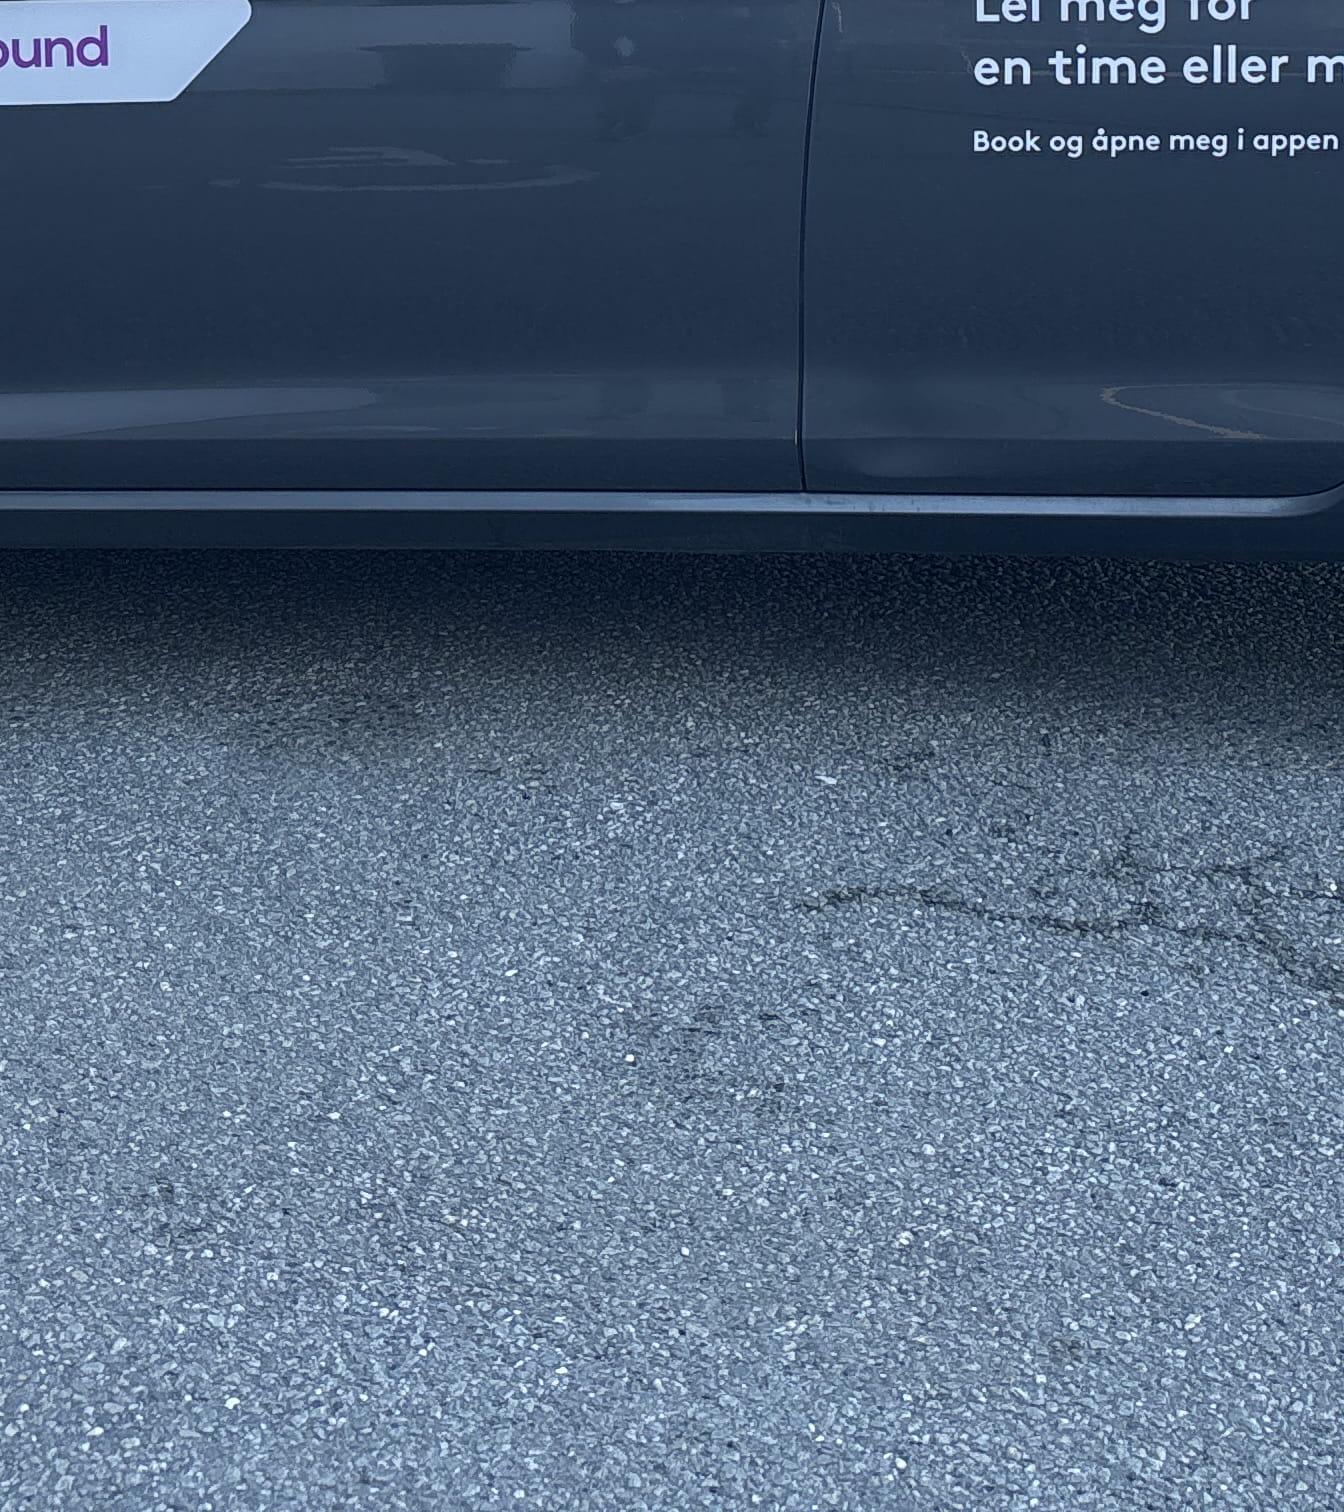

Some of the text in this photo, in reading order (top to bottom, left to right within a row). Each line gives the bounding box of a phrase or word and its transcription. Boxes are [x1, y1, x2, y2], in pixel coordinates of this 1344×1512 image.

[973, 55, 1032, 86] en
[1048, 43, 1167, 85] time
[1182, 44, 1290, 85] eller
[972, 127, 1340, 158] Book og åpne meg i appen
